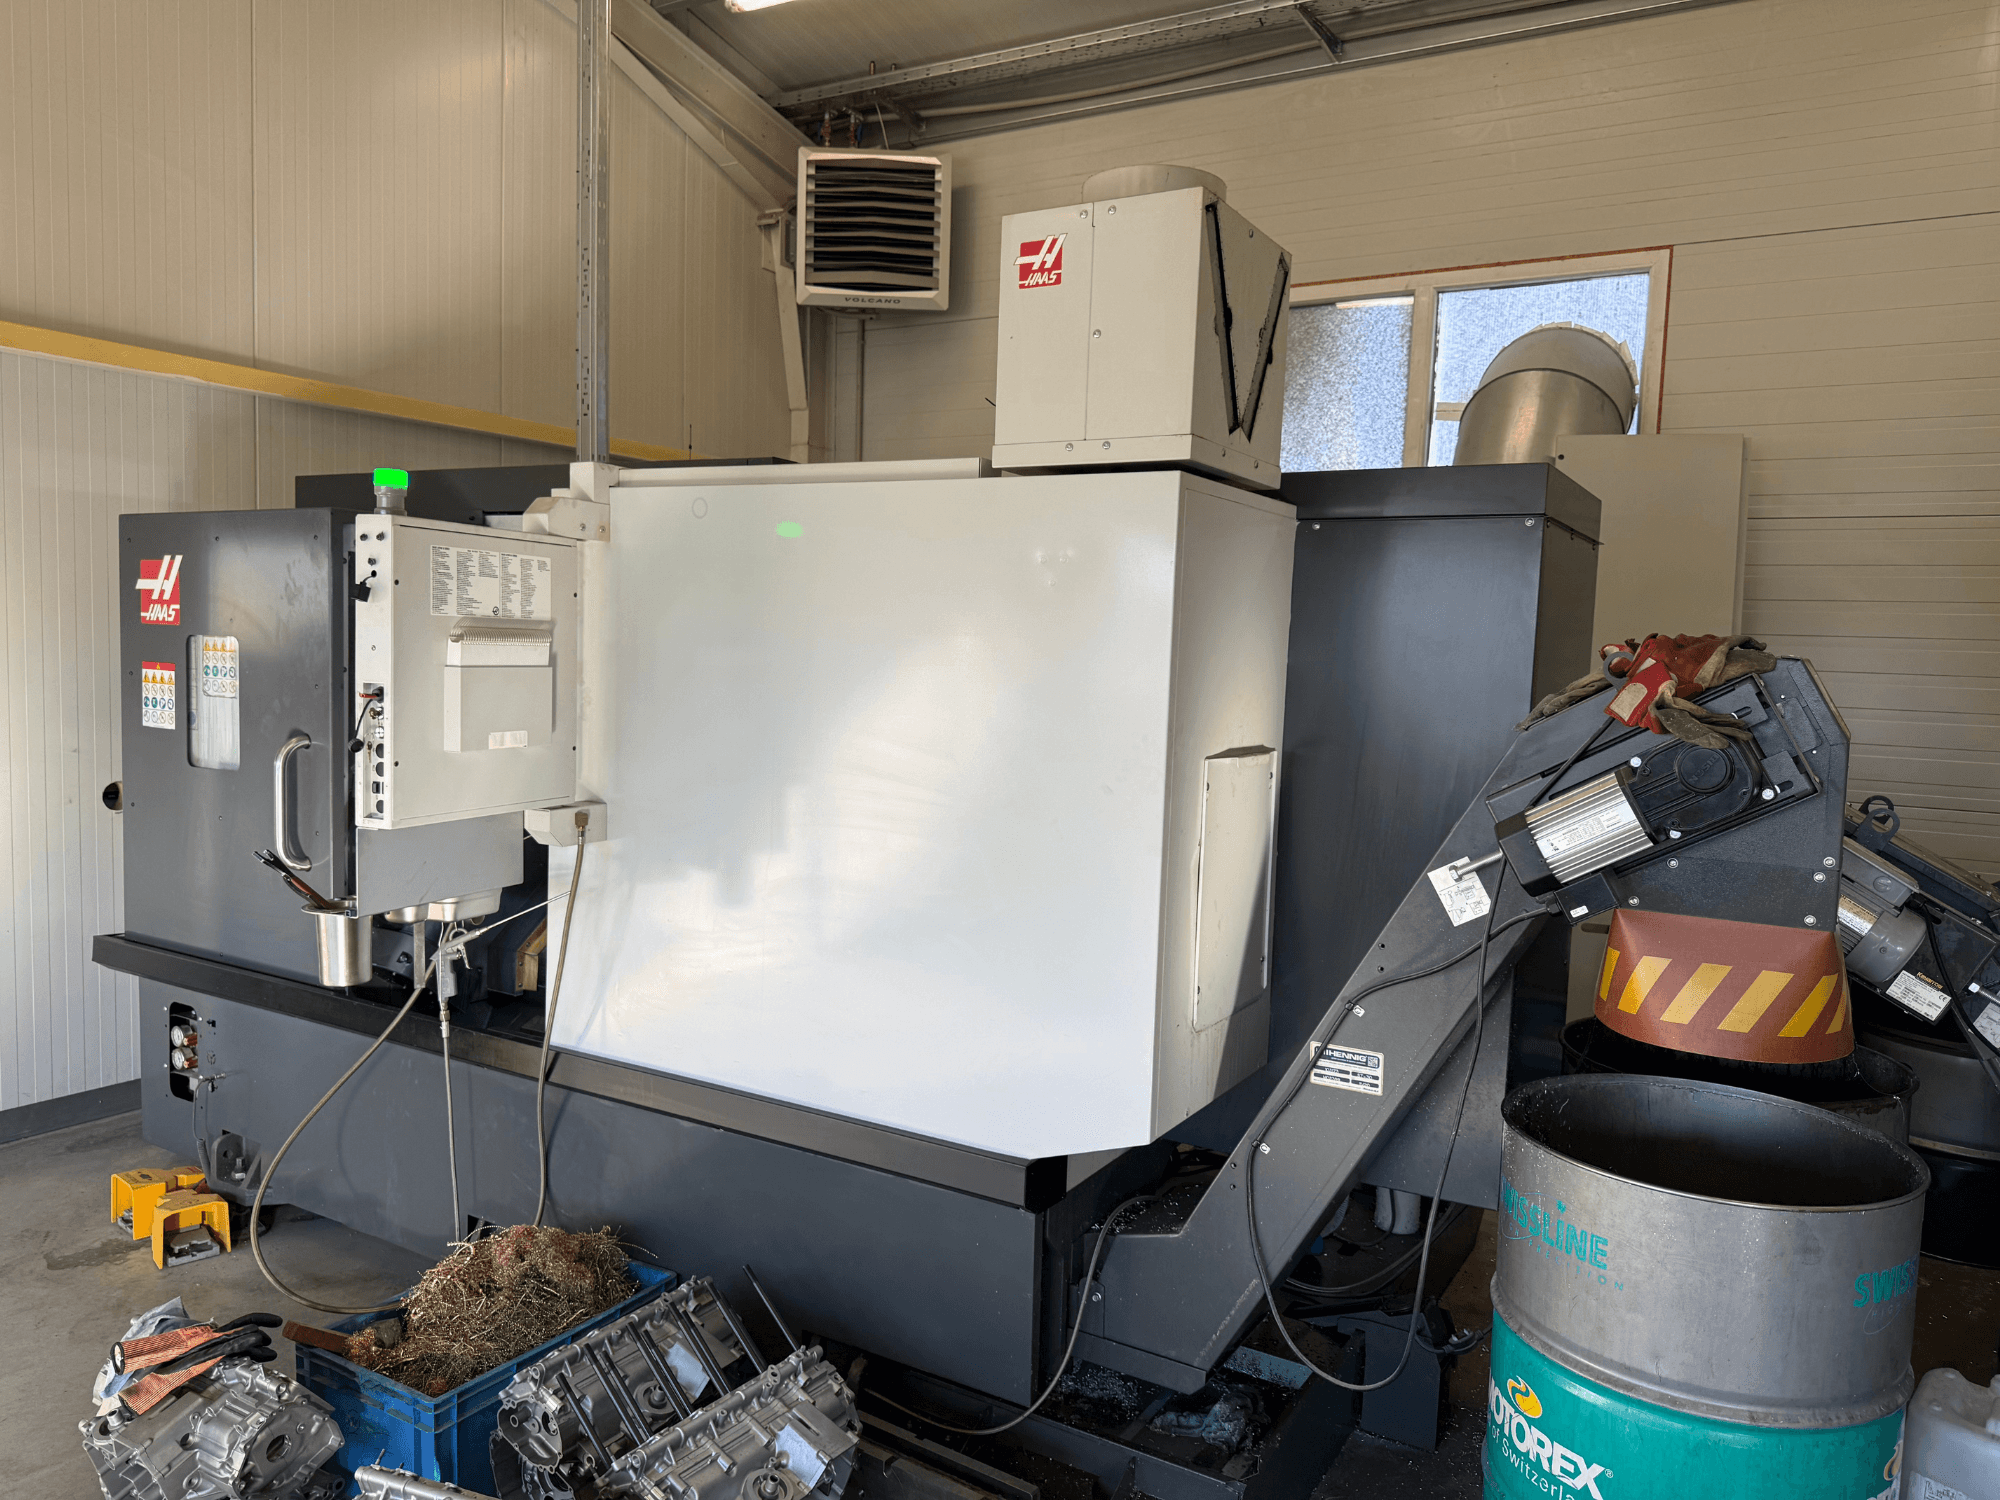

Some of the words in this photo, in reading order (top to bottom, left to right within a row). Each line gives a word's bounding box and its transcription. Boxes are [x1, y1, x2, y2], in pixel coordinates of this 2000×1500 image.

[1018, 270, 1063, 287] HAAS
[140, 603, 181, 622] HAAS
[1492, 1425, 1501, 1444] of
